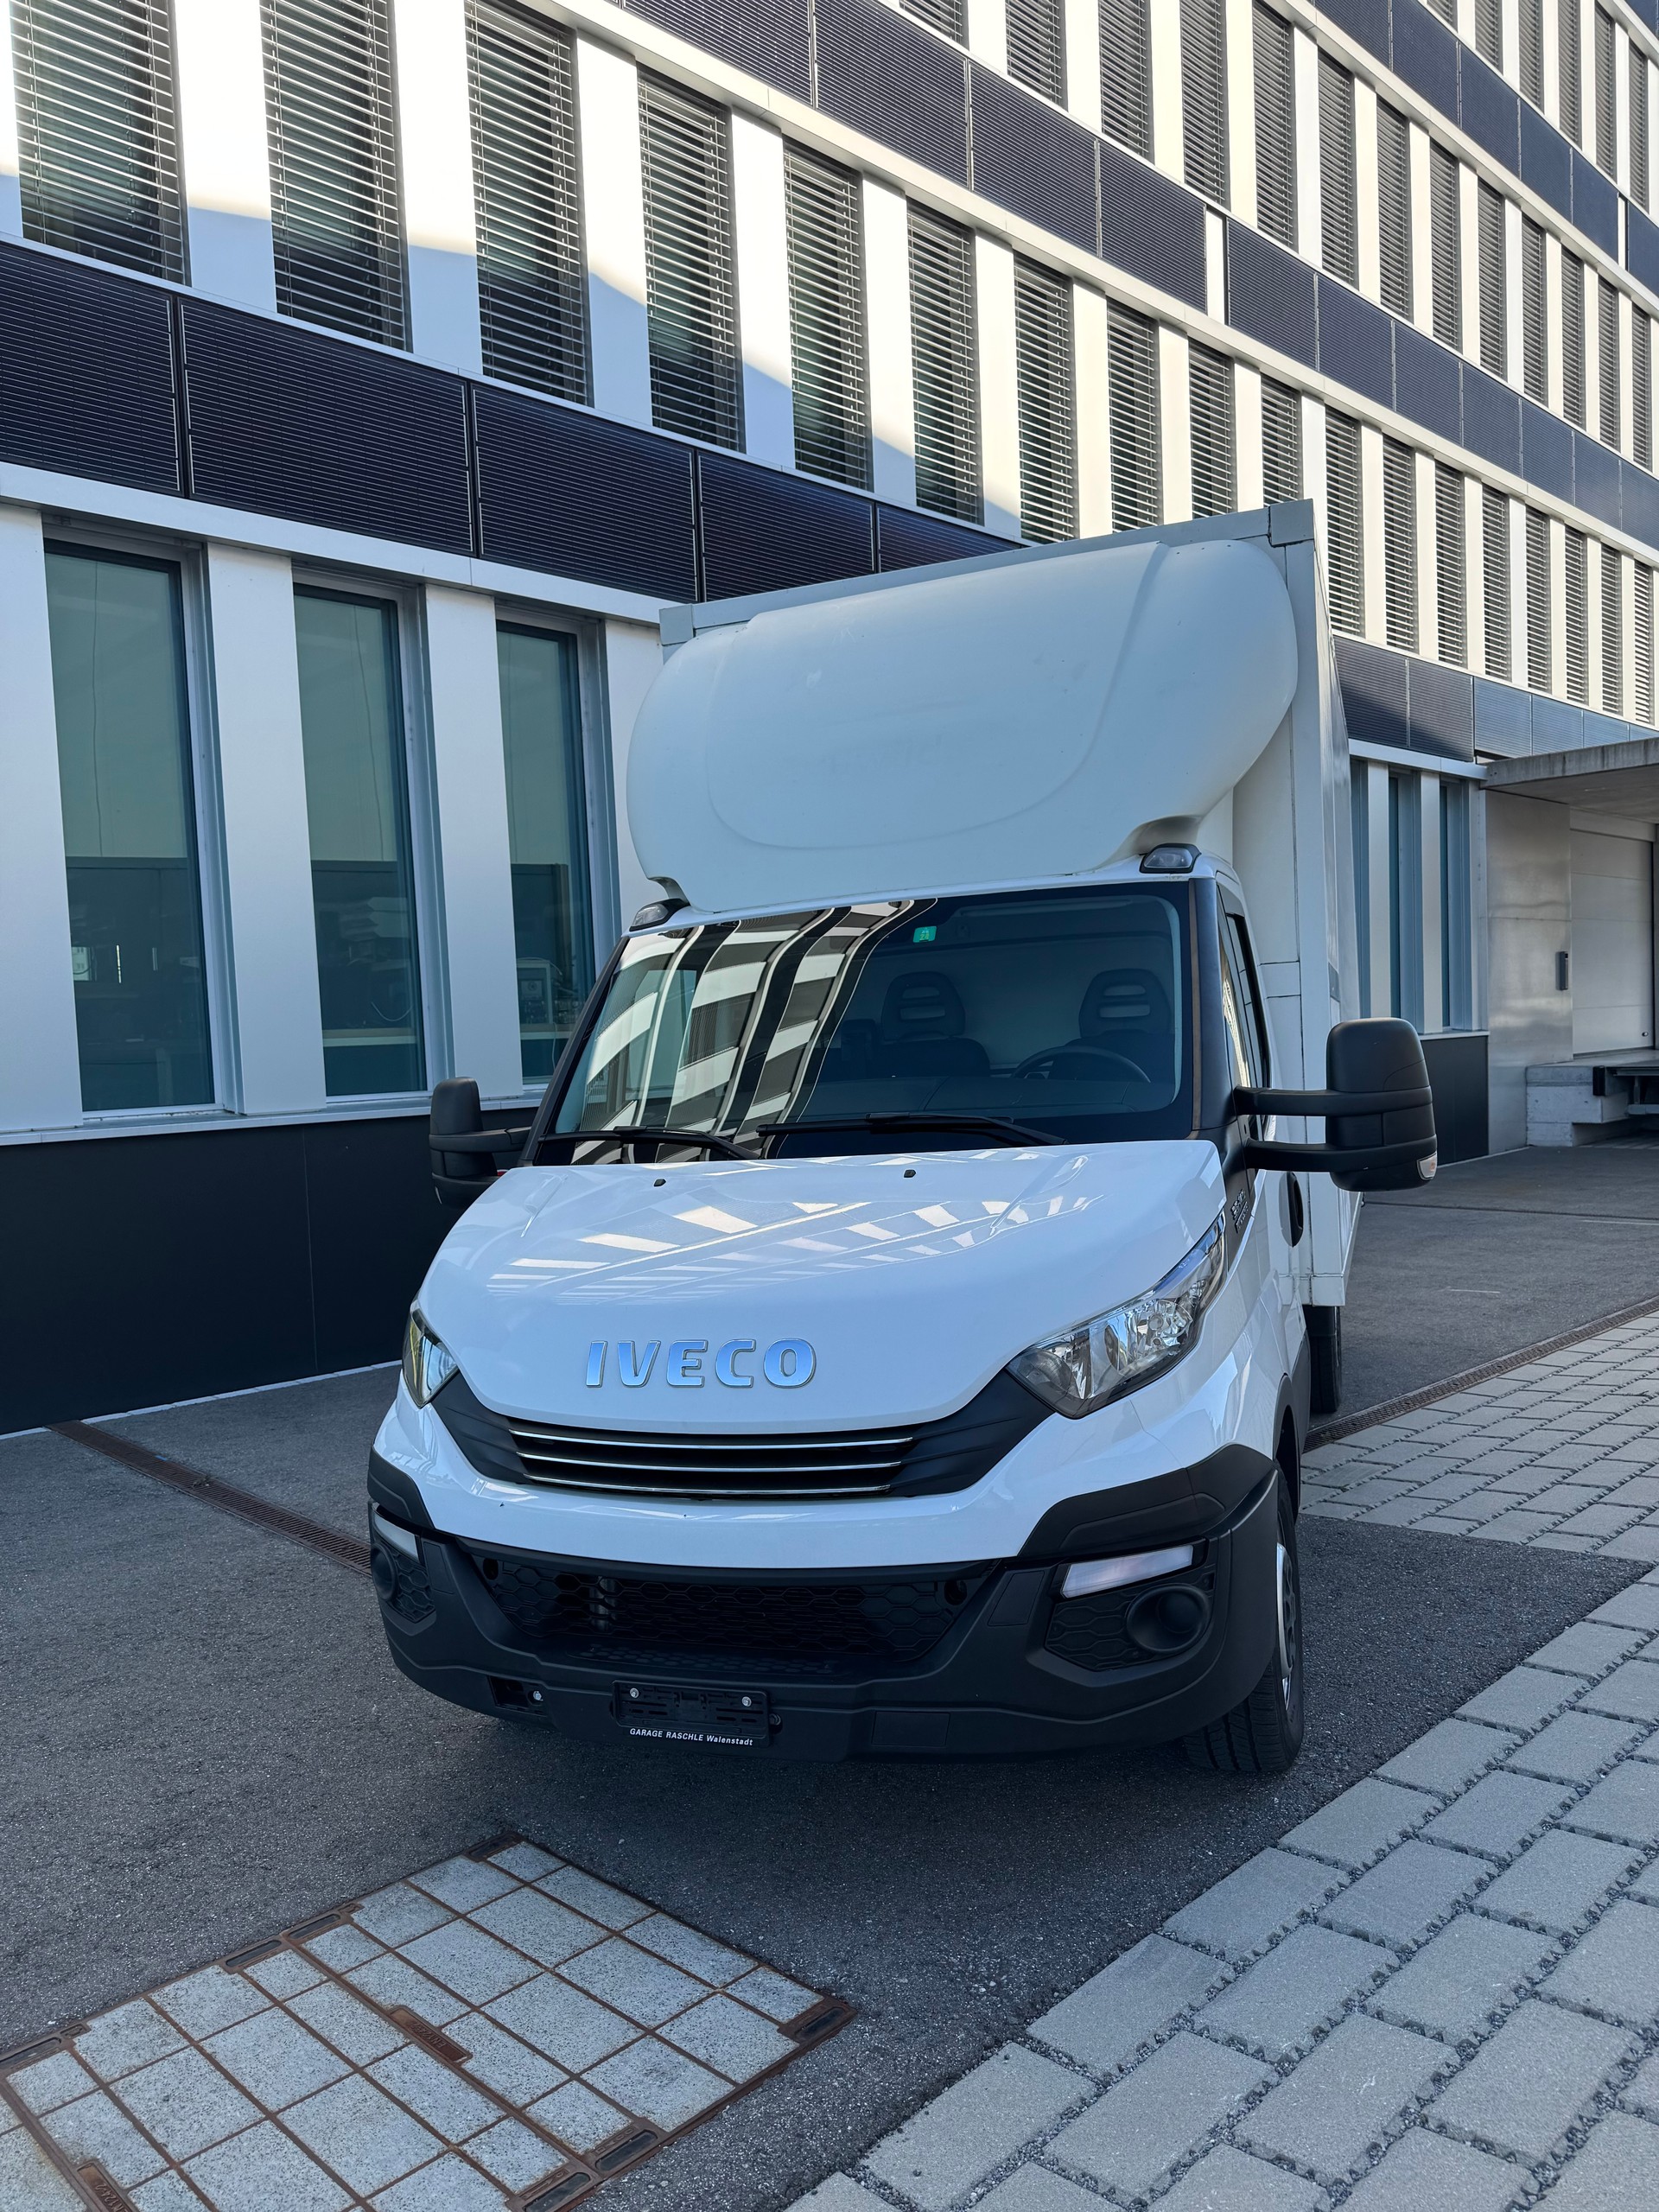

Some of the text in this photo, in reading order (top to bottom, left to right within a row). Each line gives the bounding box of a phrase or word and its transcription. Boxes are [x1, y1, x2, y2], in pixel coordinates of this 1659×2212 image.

[586, 1338, 817, 1388] IVECO
[629, 1728, 753, 1745] GARAGE RASCHLE Walenstadt
